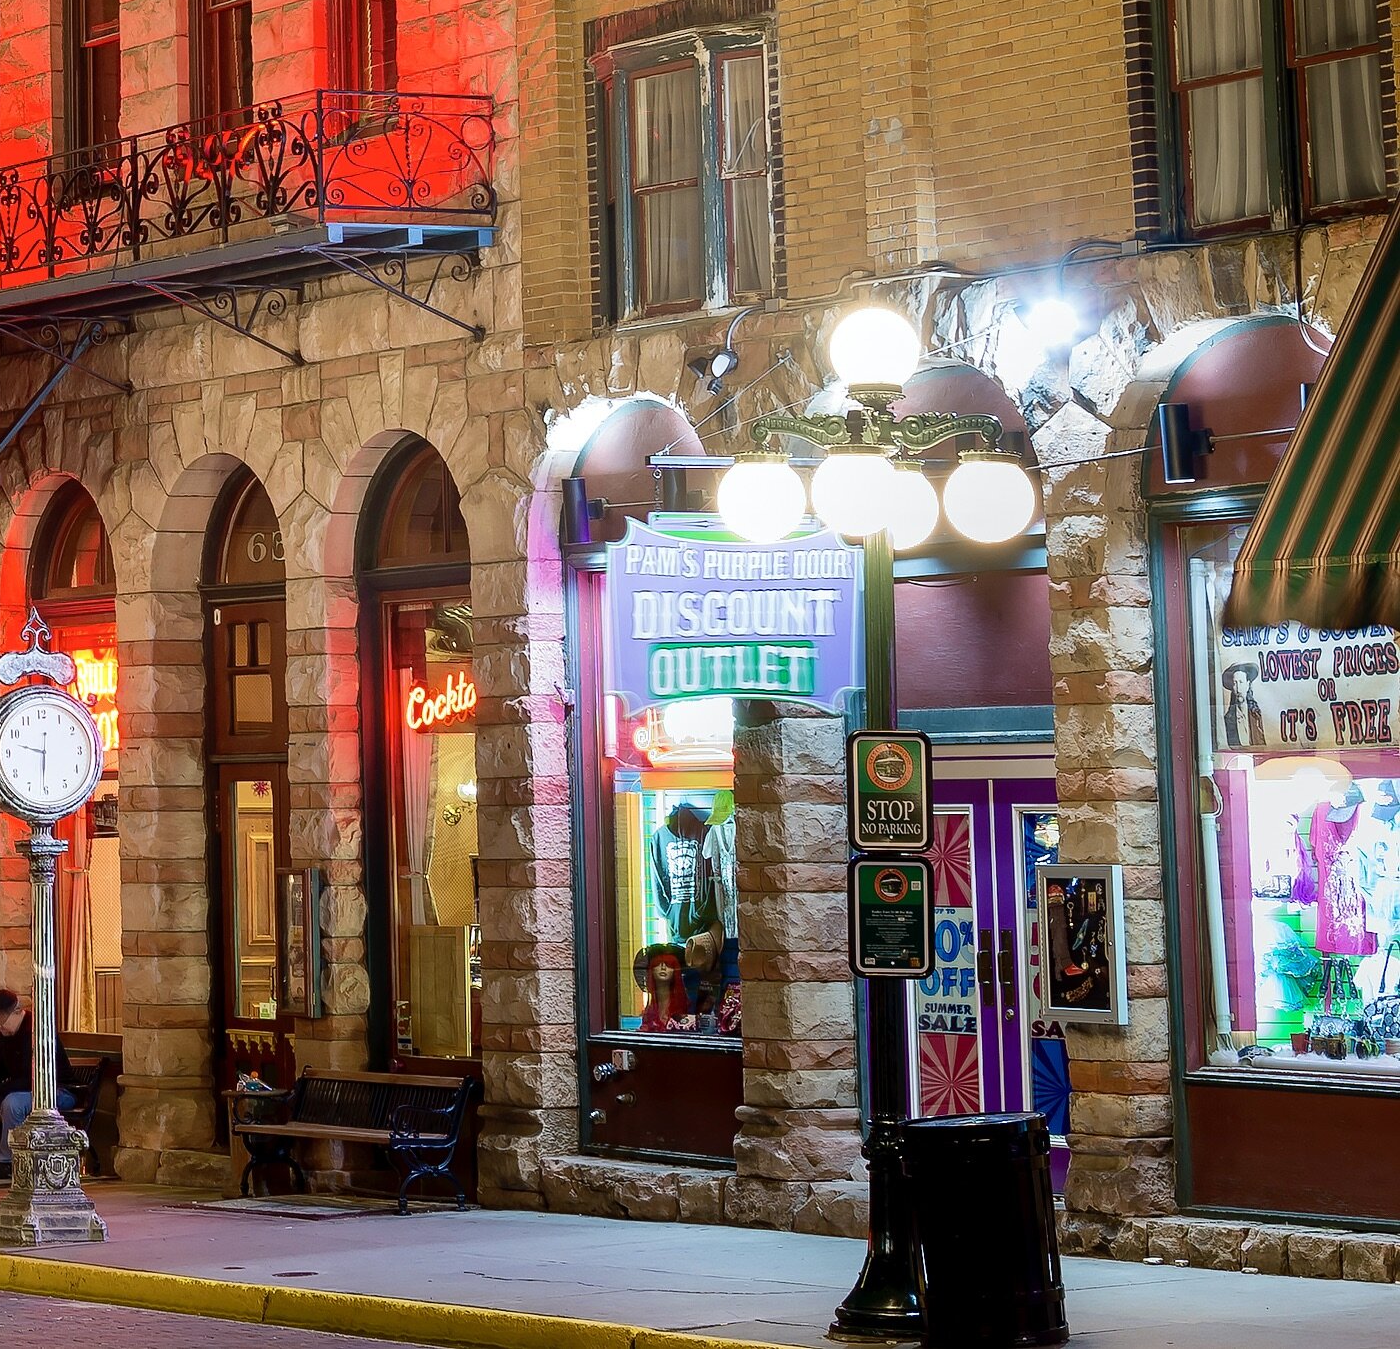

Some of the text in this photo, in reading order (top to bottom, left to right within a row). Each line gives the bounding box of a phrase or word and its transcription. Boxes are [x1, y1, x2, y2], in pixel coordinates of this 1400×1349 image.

[624, 542, 854, 581] PAM'S PURPLE DOOR
[631, 588, 843, 639] DISCOUNT
[1259, 643, 1400, 682] LOWEST PRICES
[650, 644, 820, 696] OUTLET
[1318, 678, 1337, 701] OR
[37, 709, 47, 720] 12
[57, 715, 61, 724] 1
[21, 716, 30, 726] 11
[1280, 698, 1392, 745] IT'S FREE
[10, 729, 20, 739] 10
[69, 726, 75, 736] 2
[6, 749, 11, 759] 9
[77, 746, 83, 755] 3
[12, 769, 18, 779] 8
[74, 764, 79, 774] 4
[27, 782, 31, 792] 7
[43, 785, 49, 795] 6
[62, 779, 68, 789] 5
[867, 799, 915, 821] STOP
[861, 823, 921, 835] NO PARKING
[935, 919, 974, 963] 0%
[919, 967, 975, 998] OFF
[924, 1003, 972, 1015] SUMMER
[918, 1015, 977, 1032] SALE
[1031, 1020, 1066, 1038] SA
